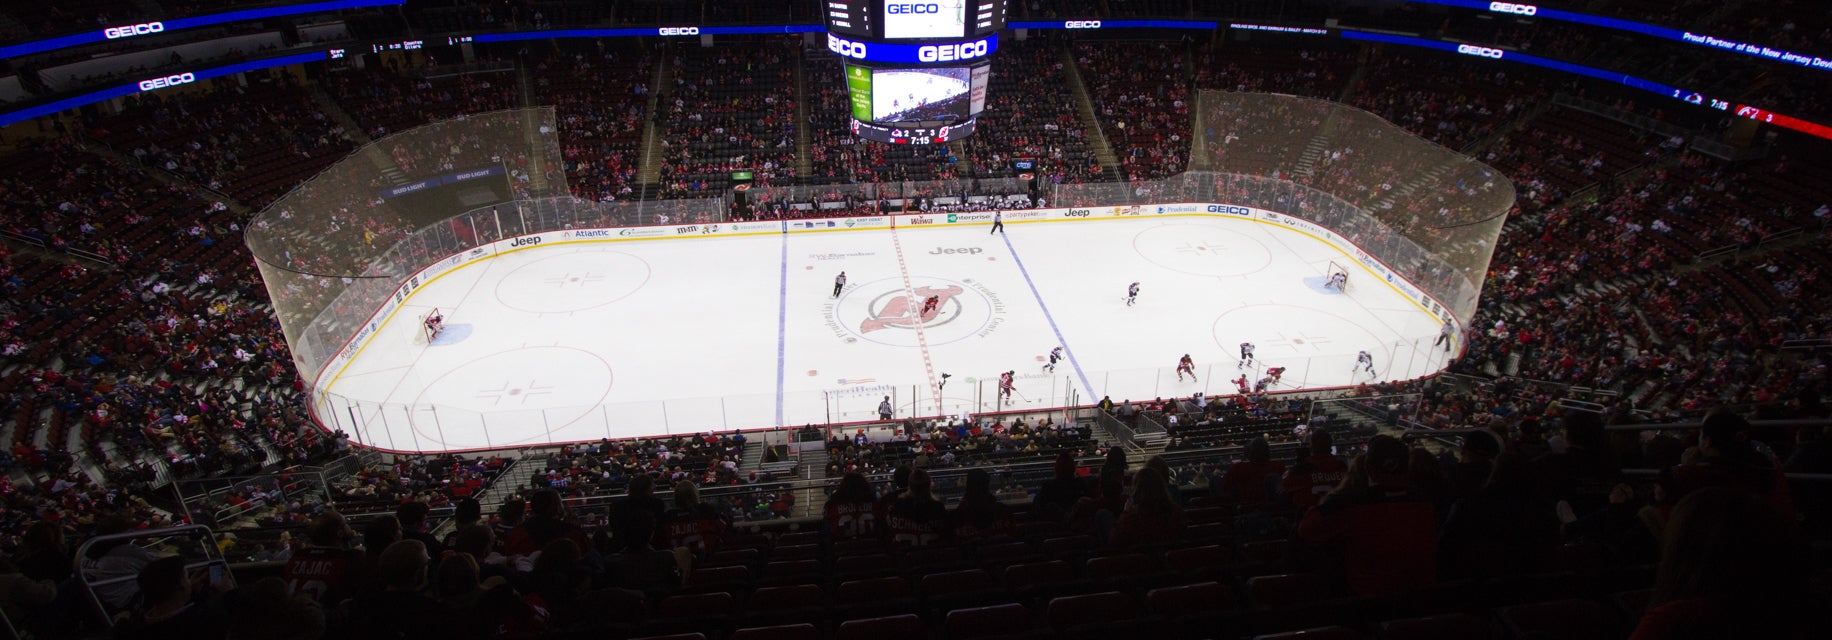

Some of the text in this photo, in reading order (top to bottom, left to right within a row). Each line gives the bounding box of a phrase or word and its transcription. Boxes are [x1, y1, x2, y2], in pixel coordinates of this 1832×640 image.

[887, 4, 939, 14] GEICO
[1489, 1, 1537, 16] GEICO
[104, 21, 165, 39] GEICO
[1064, 20, 1101, 29] GEICO
[658, 26, 699, 36] GEICO
[828, 32, 867, 59] EICO
[918, 40, 988, 62] GEICO
[1458, 44, 1504, 59] GEICO
[1683, 32, 1705, 43] Proud
[1705, 37, 1735, 49] Partner
[1746, 46, 1760, 55] the
[1761, 48, 1780, 58] New
[1781, 52, 1811, 65] Jersey
[138, 72, 196, 91] GEICO
[1673, 89, 1681, 98] 2
[1709, 99, 1729, 111] 7:15
[1765, 113, 1774, 123] 3
[904, 129, 910, 137] 2
[929, 129, 936, 137] 3
[910, 136, 930, 145] 7:15
[456, 169, 490, 181] BUD LIGHT
[392, 182, 426, 195] BUD LIGHT
[1065, 207, 1091, 219] Jeep
[1207, 205, 1250, 217] GEICO
[575, 229, 609, 238] Atlantic
[510, 235, 541, 248] Jeep
[928, 247, 983, 255] Jeep
[977, 317, 1005, 338] Center
[292, 560, 333, 576] ZAJAC
